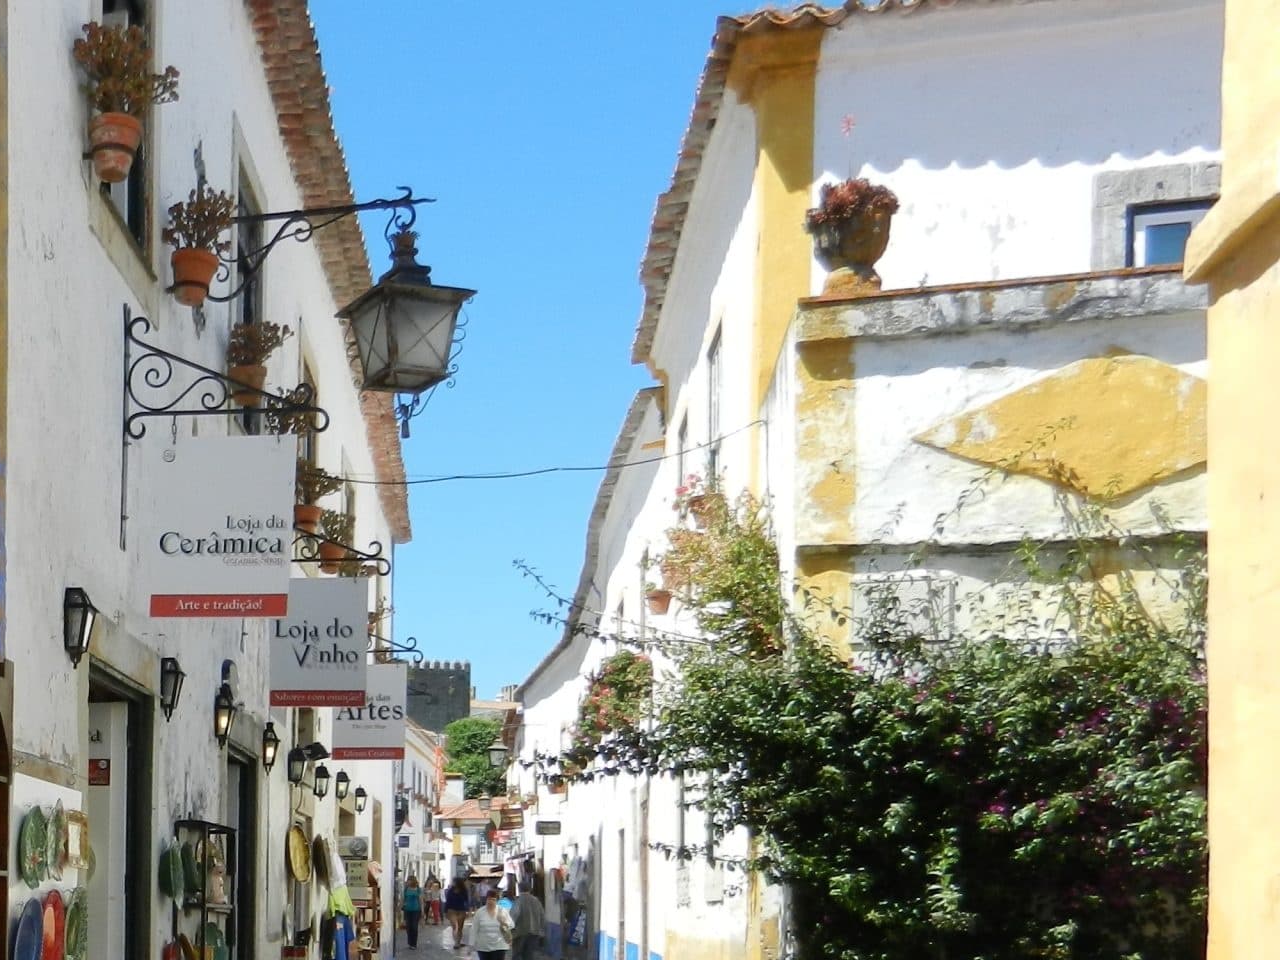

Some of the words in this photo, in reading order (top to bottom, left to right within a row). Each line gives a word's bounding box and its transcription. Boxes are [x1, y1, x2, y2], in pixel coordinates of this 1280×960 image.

[226, 515, 260, 532] Loja
[266, 515, 285, 529] da
[159, 530, 284, 555] Cerâmica
[176, 600, 200, 611] Arte
[203, 602, 210, 611] e
[213, 599, 263, 612] tradição!
[275, 619, 319, 644] Loja
[326, 617, 353, 639] do
